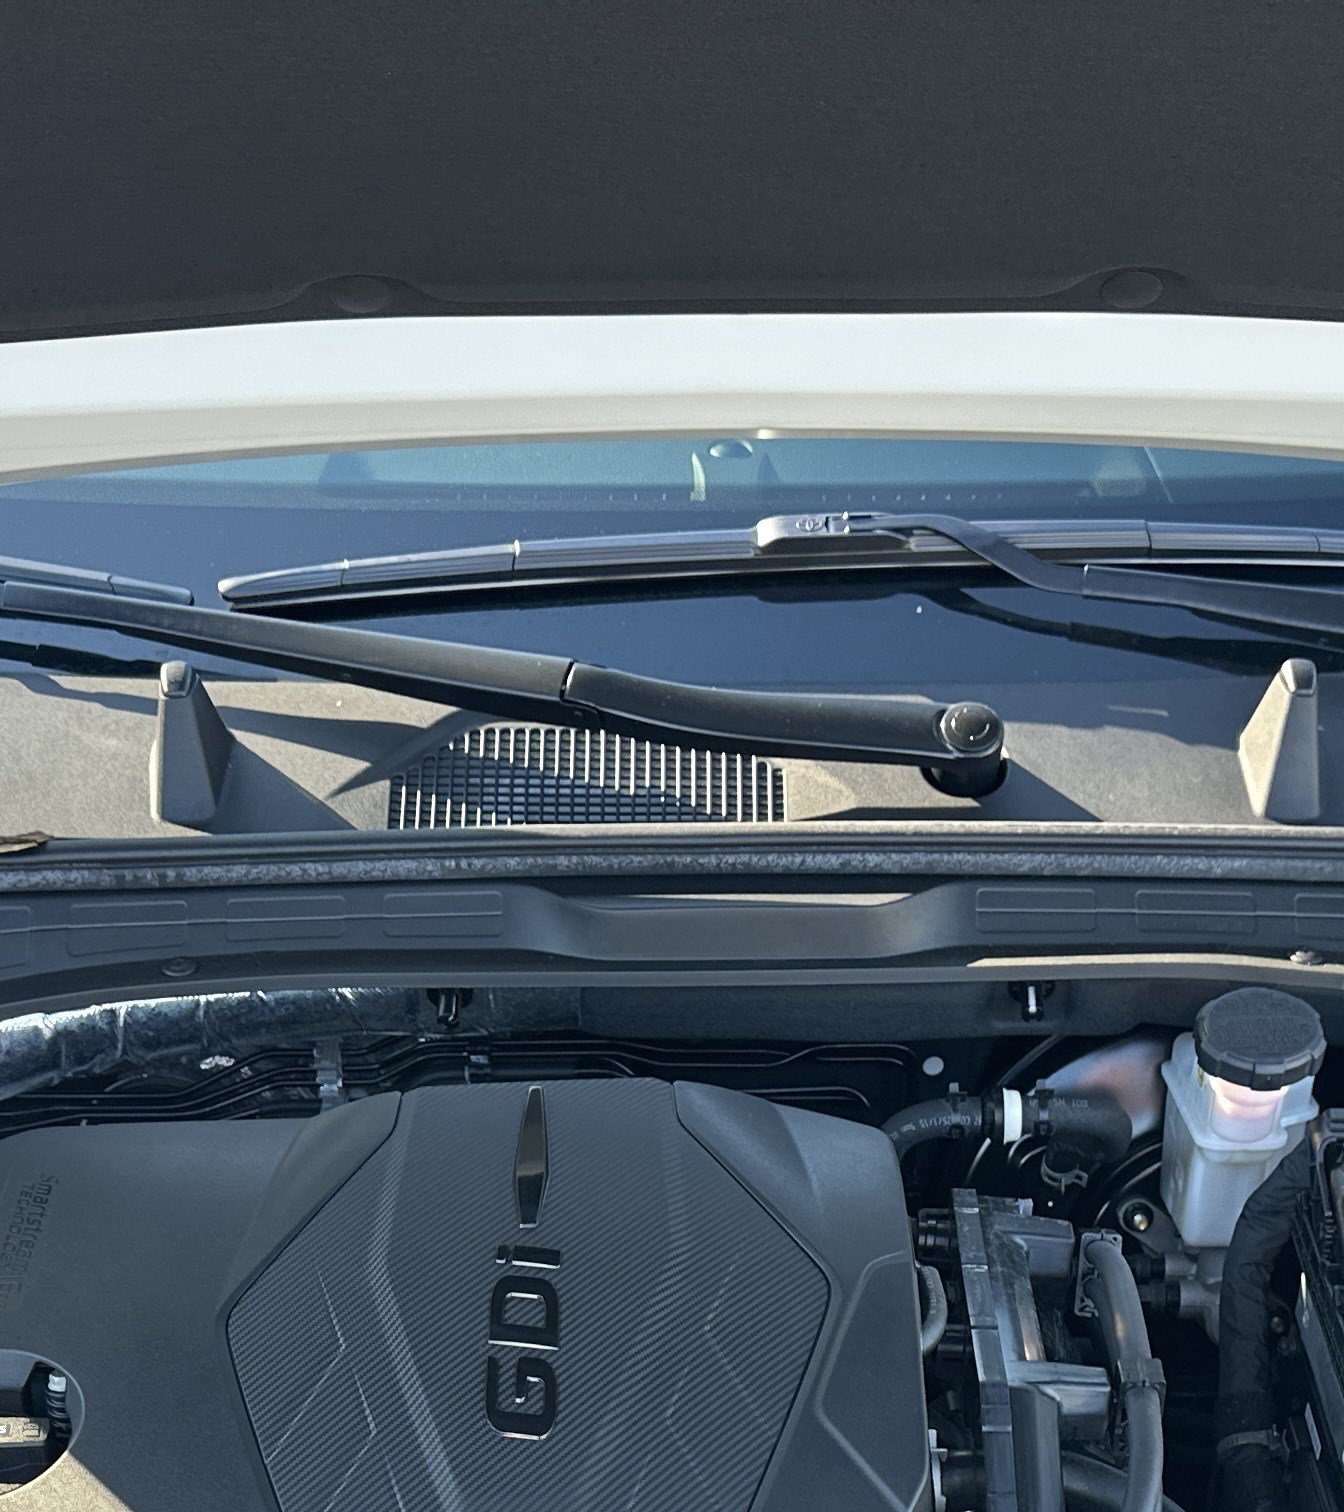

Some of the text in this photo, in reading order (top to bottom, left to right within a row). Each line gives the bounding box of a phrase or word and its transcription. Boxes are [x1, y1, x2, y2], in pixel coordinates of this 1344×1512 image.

[0, 1183, 36, 1273] TECHNOLOGY
[15, 1173, 60, 1274] Smartstream
[485, 1244, 563, 1441] GDi
